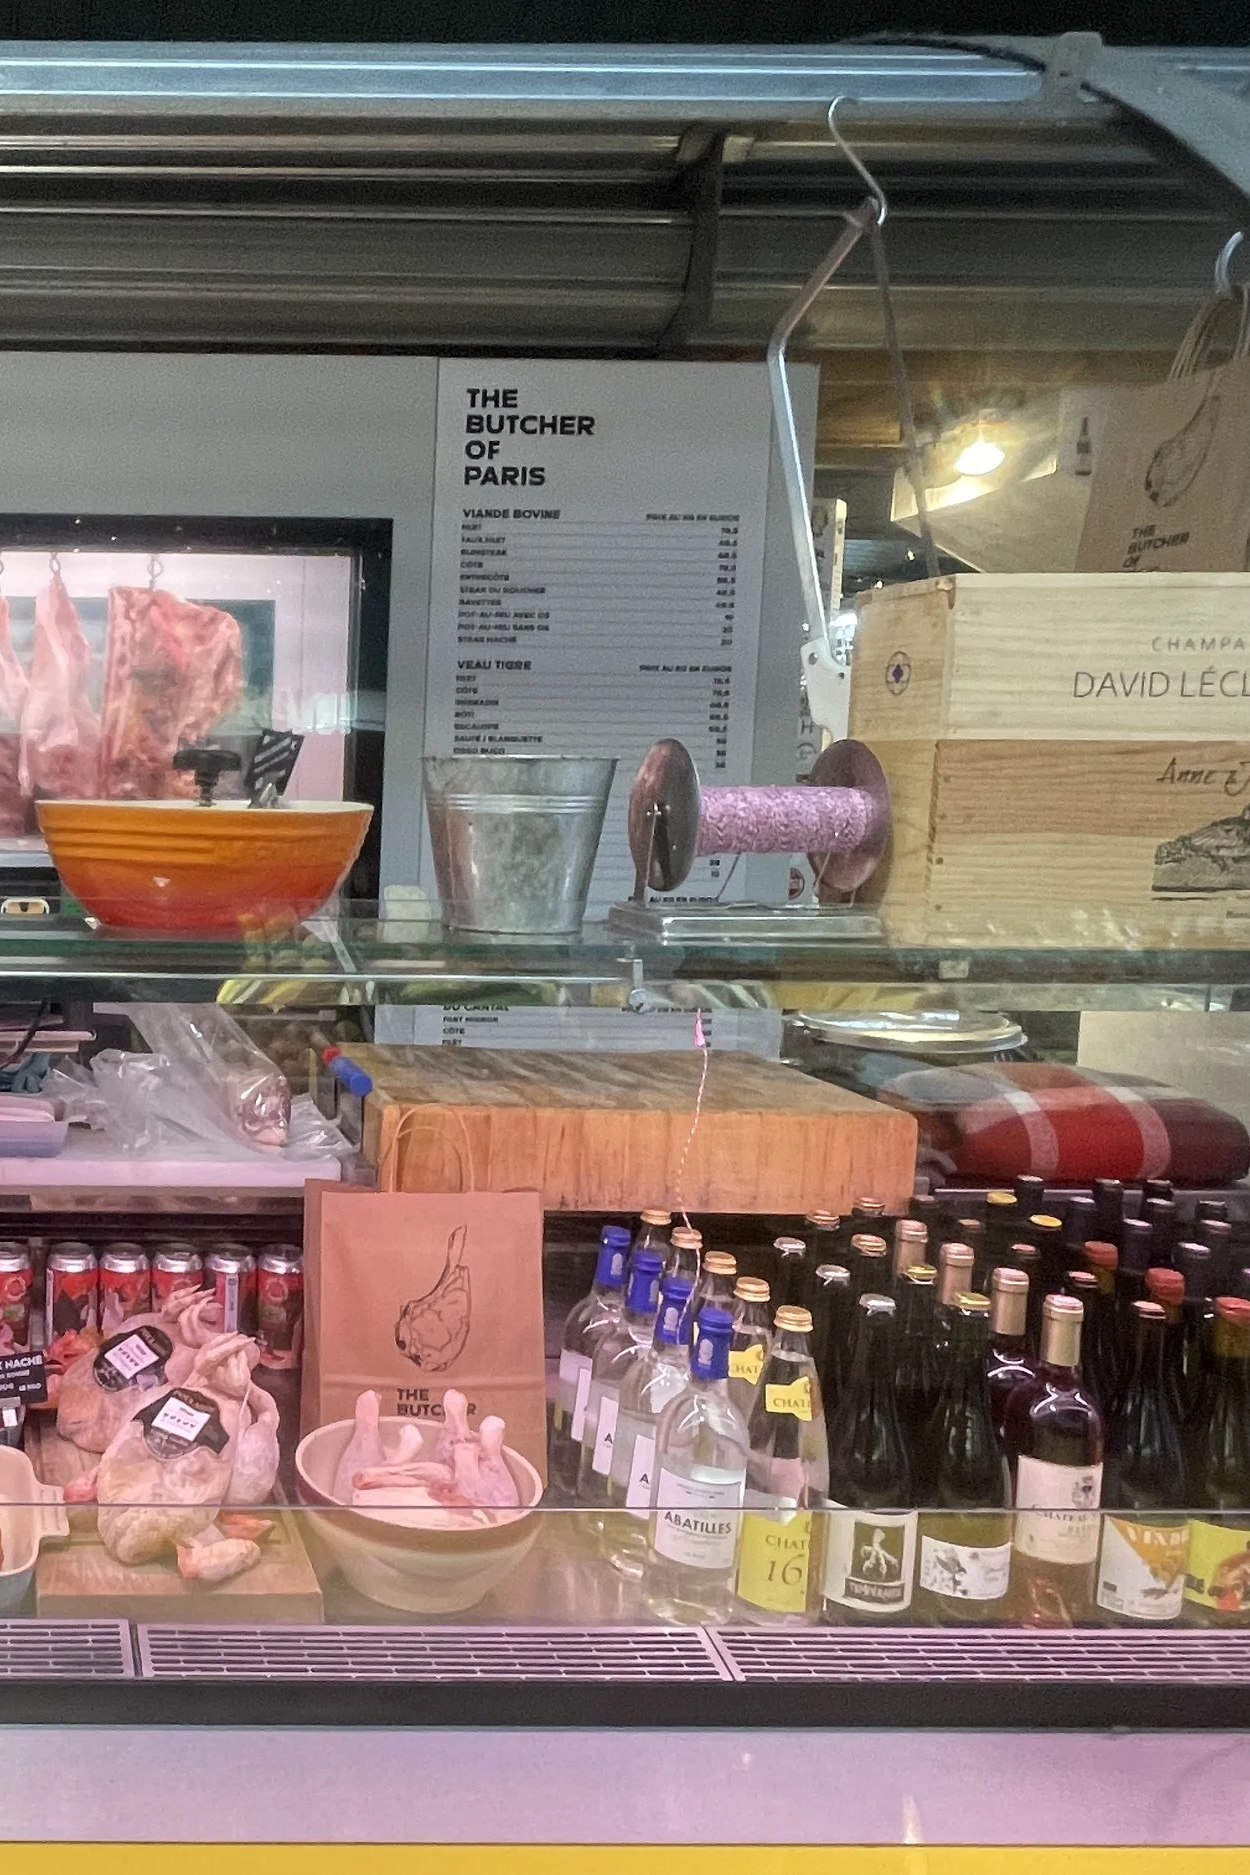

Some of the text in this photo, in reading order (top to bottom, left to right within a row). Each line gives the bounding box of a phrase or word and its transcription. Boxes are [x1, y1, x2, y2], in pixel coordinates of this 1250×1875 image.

[466, 388, 519, 408] THE
[465, 414, 596, 435] BUTCHER
[464, 440, 501, 460] OF
[463, 466, 546, 486] PARIS
[463, 508, 560, 519] VIANDE BOVINE
[1131, 524, 1157, 539] THE
[1151, 636, 1246, 652] CHAMPA
[457, 660, 492, 670] VEAU
[1073, 670, 1171, 698] DAVID
[1156, 757, 1216, 785] Anne
[396, 1387, 429, 1402] THE
[773, 1397, 810, 1408] CHAT
[396, 1402, 477, 1416] BUTCR
[664, 1510, 732, 1535] ABATILLES
[765, 1534, 806, 1550] CHAT
[767, 1553, 805, 1586] 16
